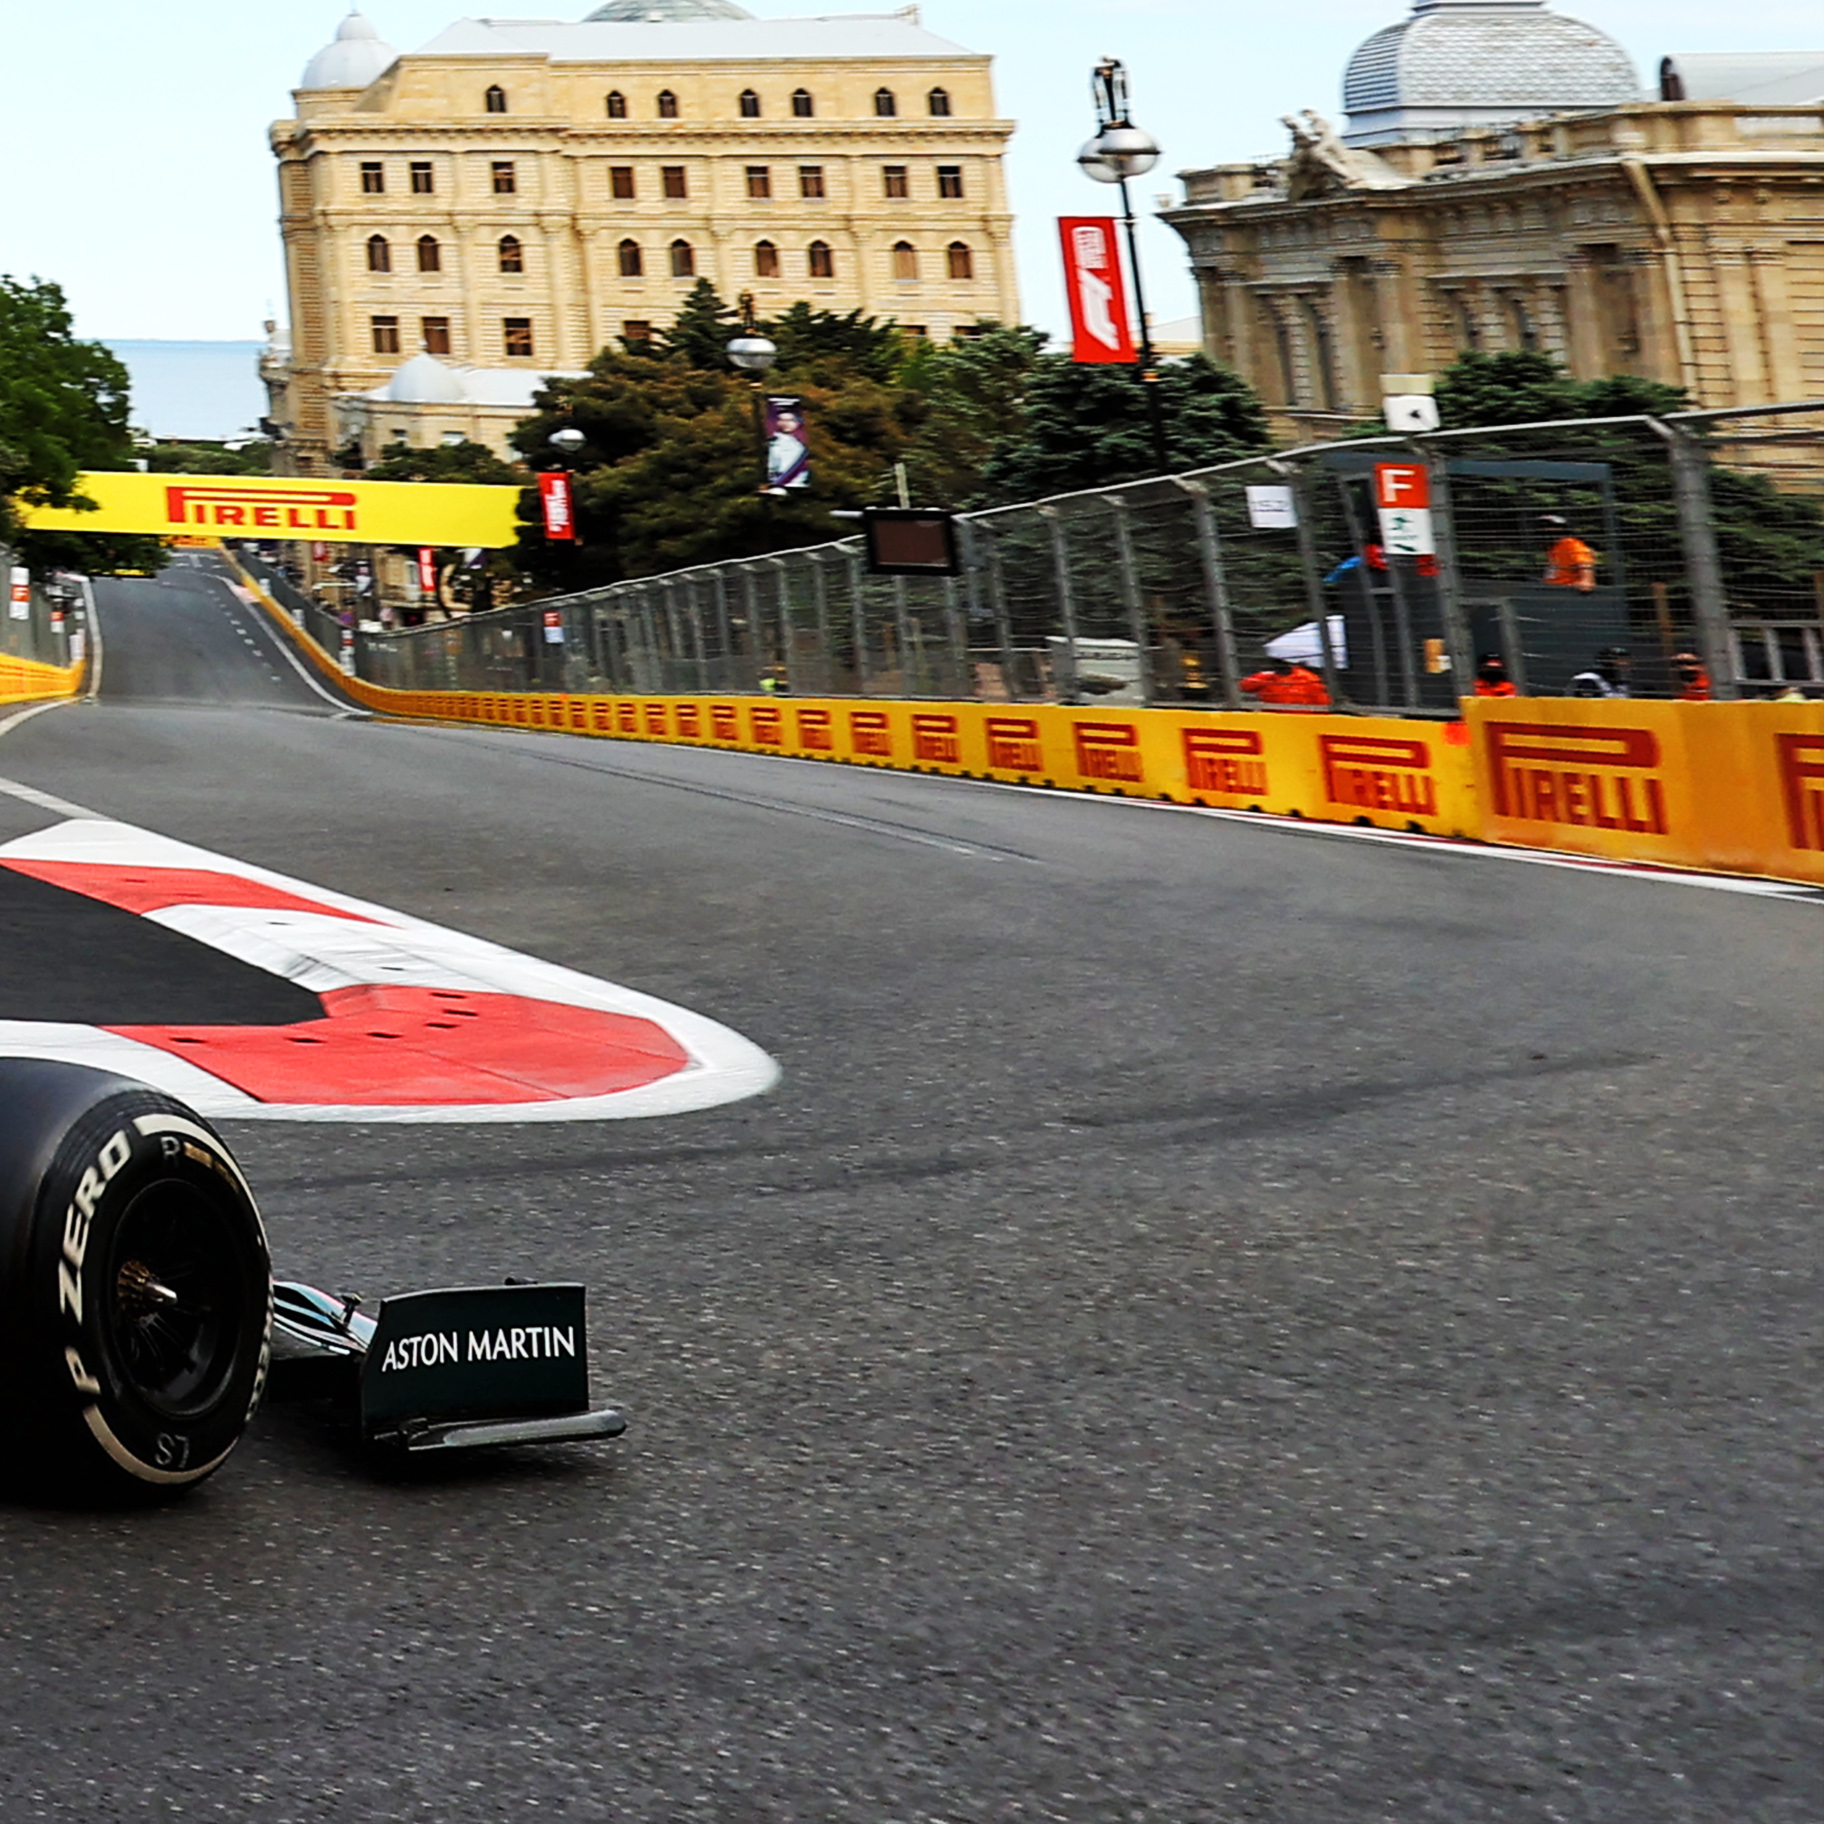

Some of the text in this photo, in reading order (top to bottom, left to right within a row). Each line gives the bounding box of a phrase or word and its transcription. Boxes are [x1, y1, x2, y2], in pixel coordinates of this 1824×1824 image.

[167, 487, 355, 530] PIRELLI
[1381, 468, 1415, 502] F
[1319, 734, 1437, 816] PIRELLI
[1485, 721, 1670, 835] PIRELLI
[59, 1130, 132, 1327] ZERO
[381, 1325, 576, 1372] ASTON MARTIN
